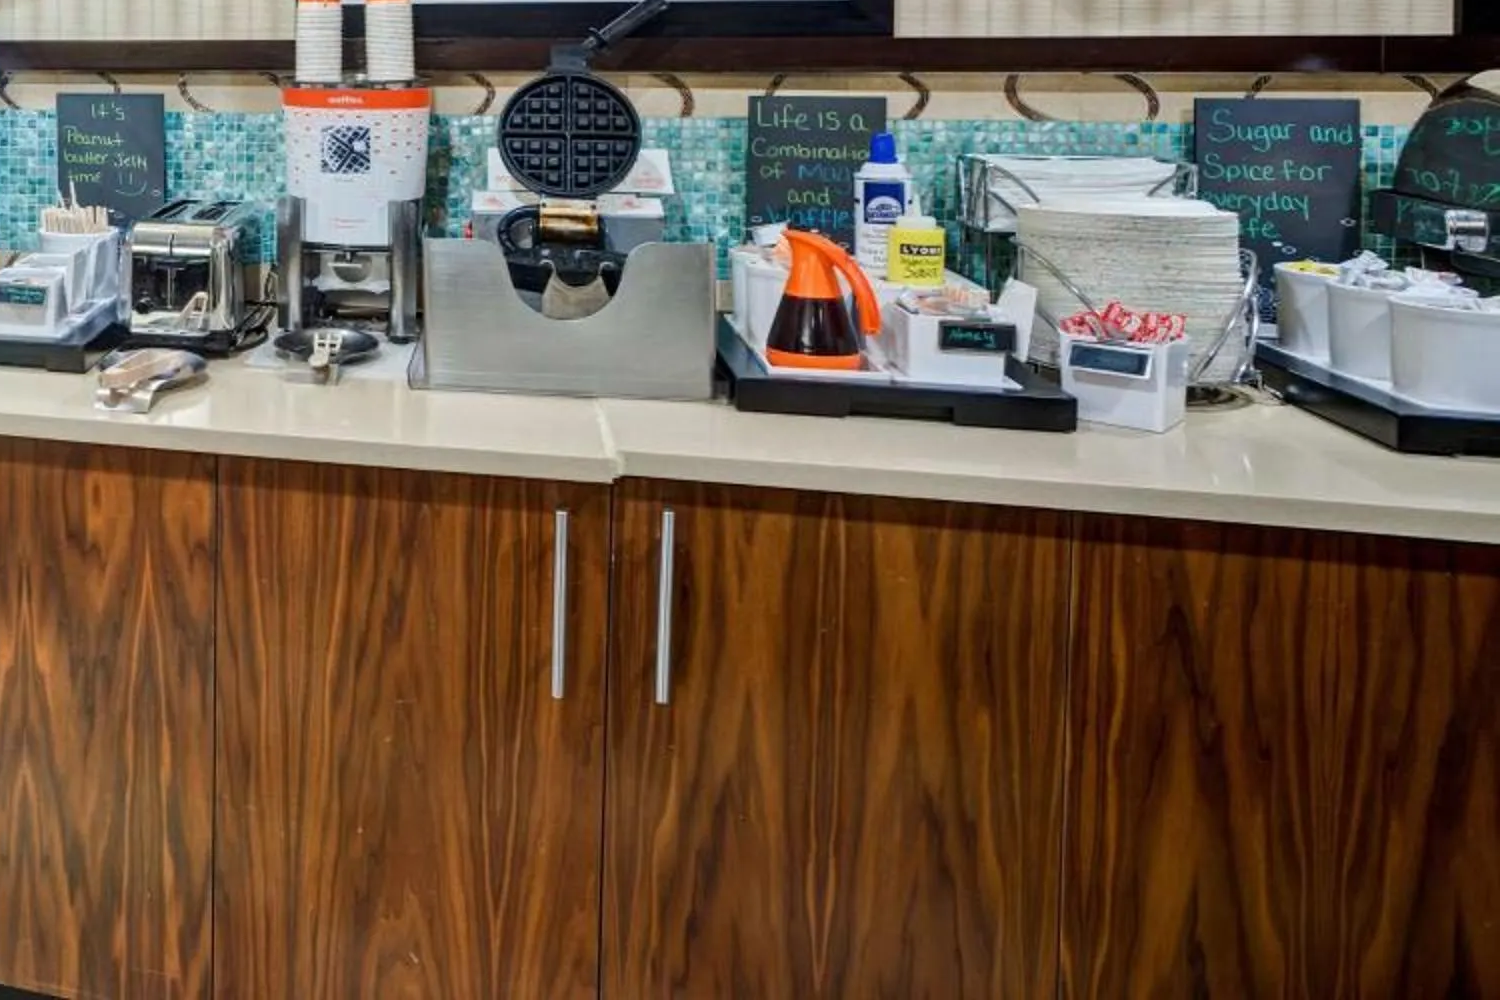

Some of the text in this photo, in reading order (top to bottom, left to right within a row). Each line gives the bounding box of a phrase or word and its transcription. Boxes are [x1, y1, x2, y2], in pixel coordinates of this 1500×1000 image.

[91, 101, 125, 120] It's
[756, 101, 869, 131] Life is a
[63, 125, 124, 146] Peanut
[1207, 108, 1354, 153] Sugar and
[751, 137, 869, 161] Combinatio
[760, 161, 786, 179] of
[1202, 153, 1332, 183] Spice for
[787, 187, 831, 205] and
